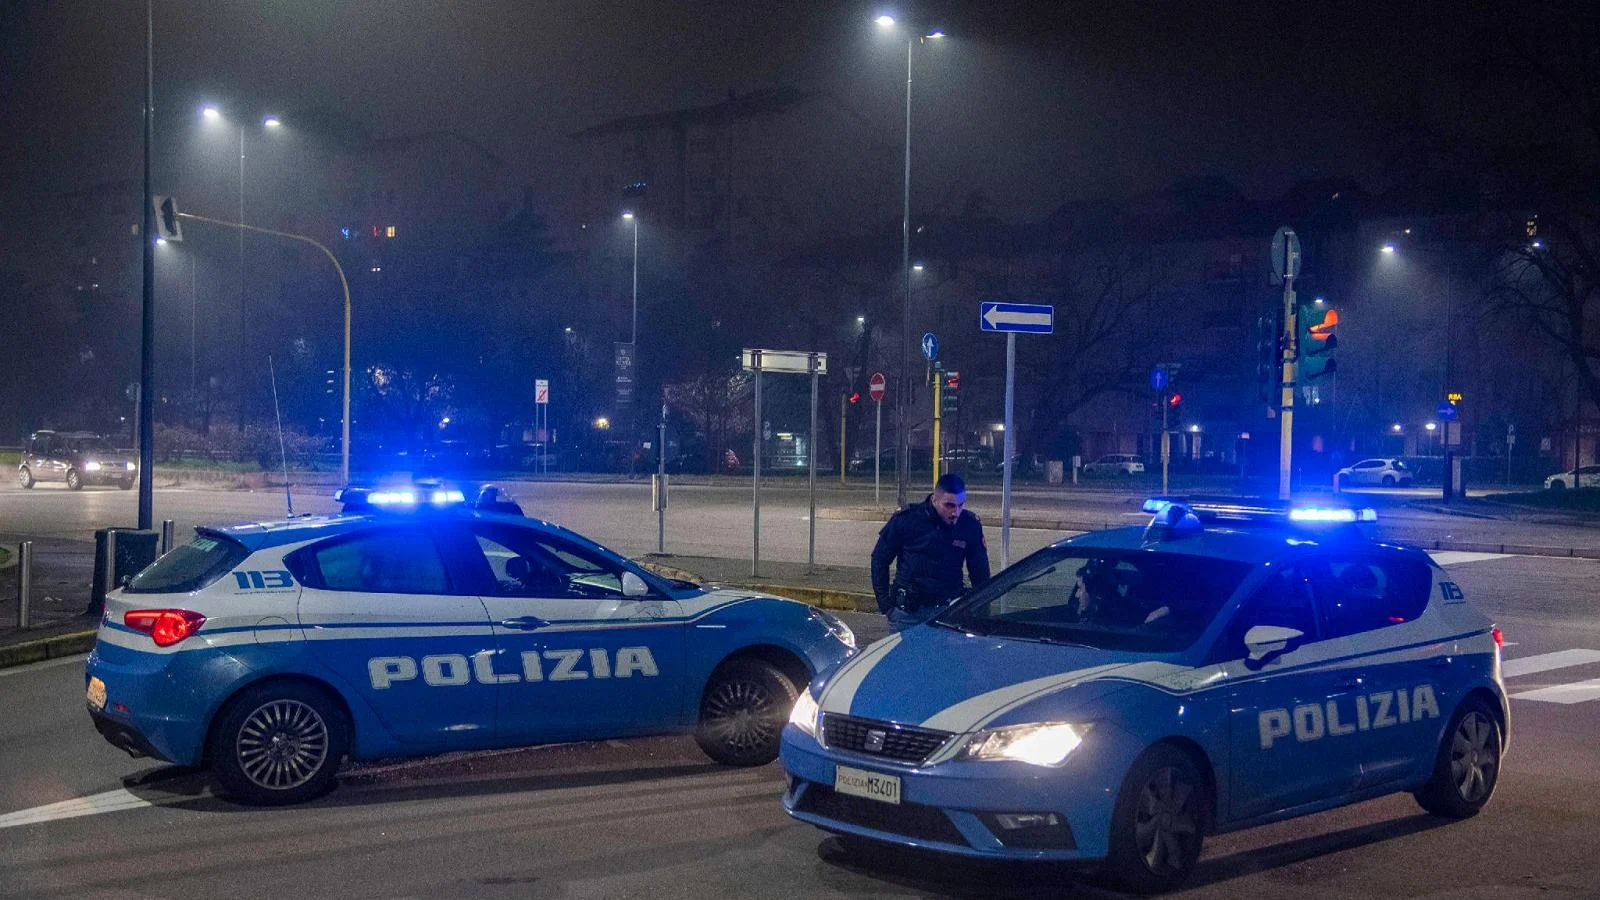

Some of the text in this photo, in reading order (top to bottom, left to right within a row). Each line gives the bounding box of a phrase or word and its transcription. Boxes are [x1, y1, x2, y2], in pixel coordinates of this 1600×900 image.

[232, 570, 294, 589] 113
[1438, 581, 1464, 600] 113
[368, 646, 659, 689] POLIZIA
[1258, 683, 1441, 750] POLIZIA
[867, 776, 897, 798] M3401
